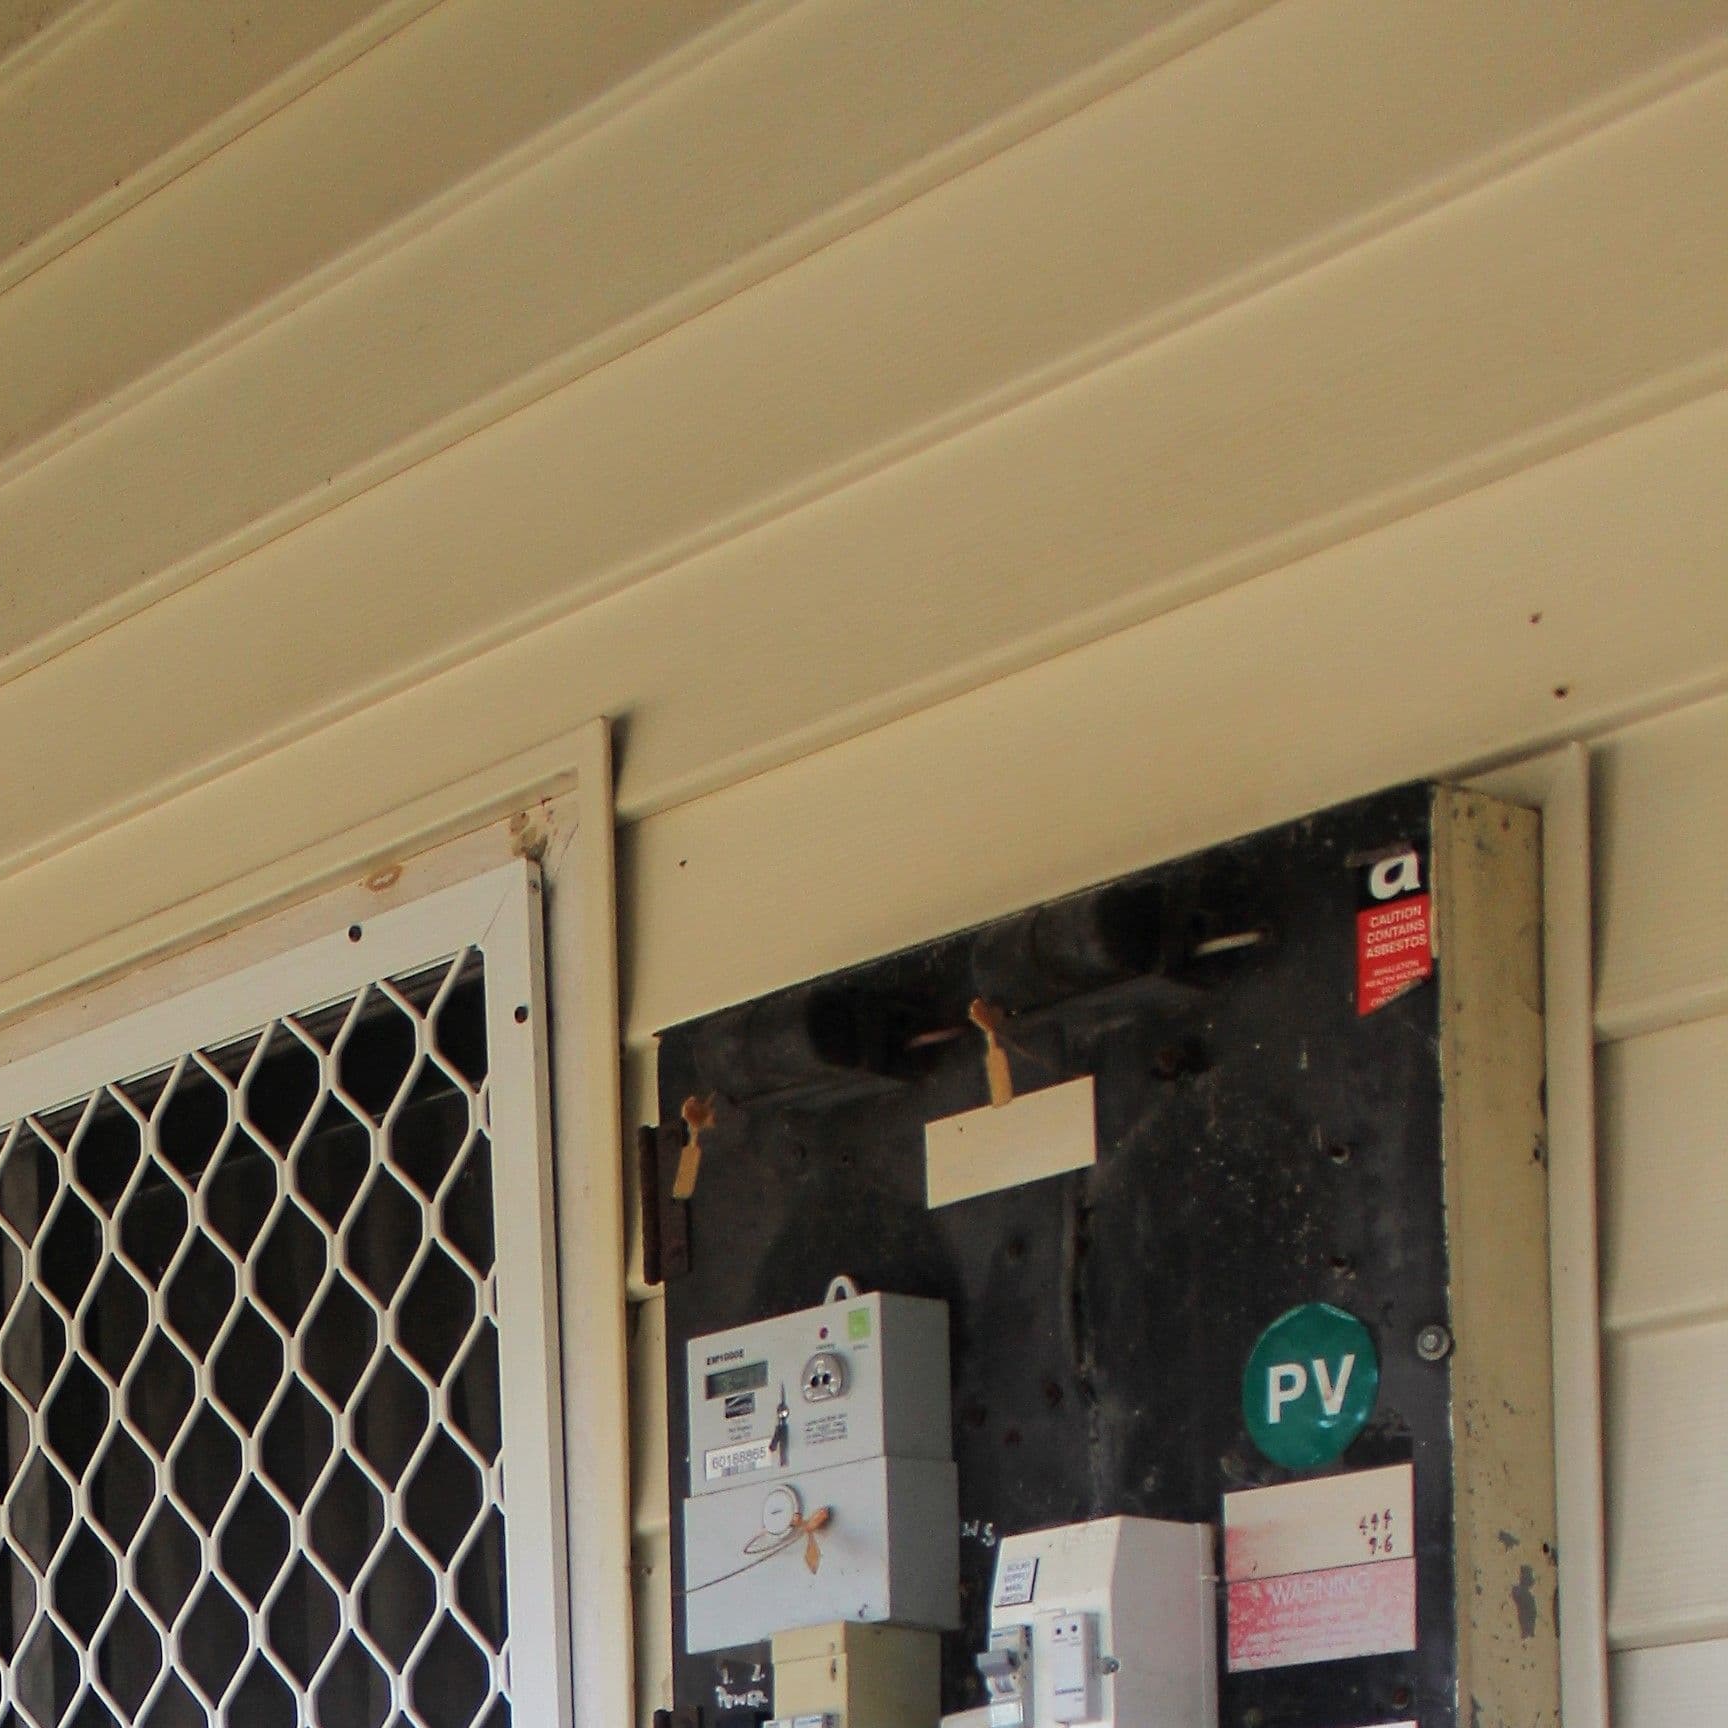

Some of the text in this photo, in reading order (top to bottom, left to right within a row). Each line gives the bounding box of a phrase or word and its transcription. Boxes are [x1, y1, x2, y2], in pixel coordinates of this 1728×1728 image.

[1371, 905, 1421, 928] CAUTION
[1367, 919, 1425, 945] CONTAINS
[1366, 933, 1427, 958] ASBESTOS
[1268, 1353, 1355, 1424] PV
